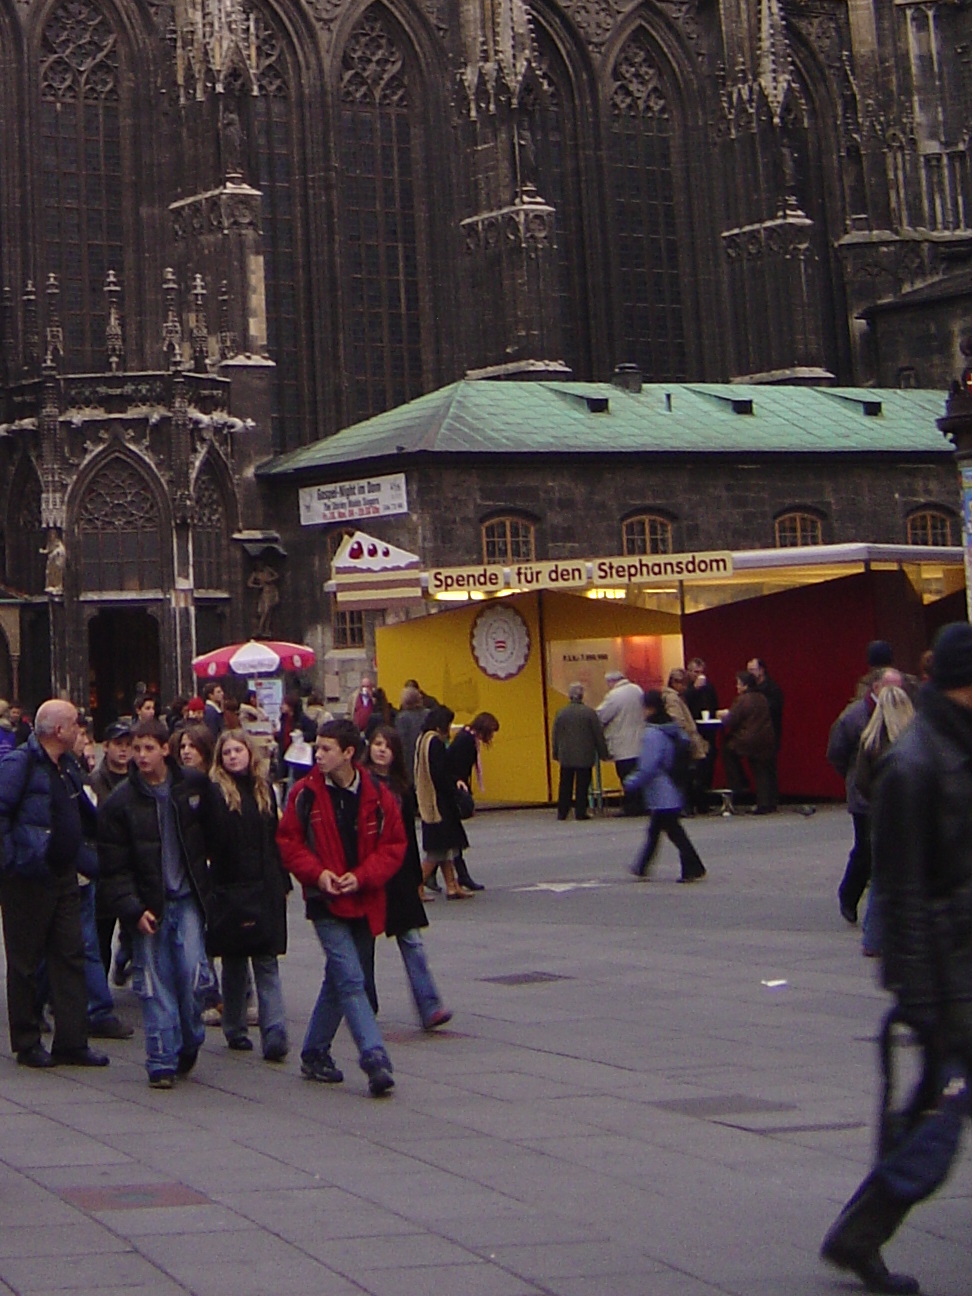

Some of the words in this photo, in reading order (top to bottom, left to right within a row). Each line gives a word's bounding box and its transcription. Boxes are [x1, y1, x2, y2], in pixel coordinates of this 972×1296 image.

[432, 568, 500, 591] Spende
[515, 565, 542, 585] für
[548, 565, 582, 583] den
[596, 555, 728, 582] Stephansdom
